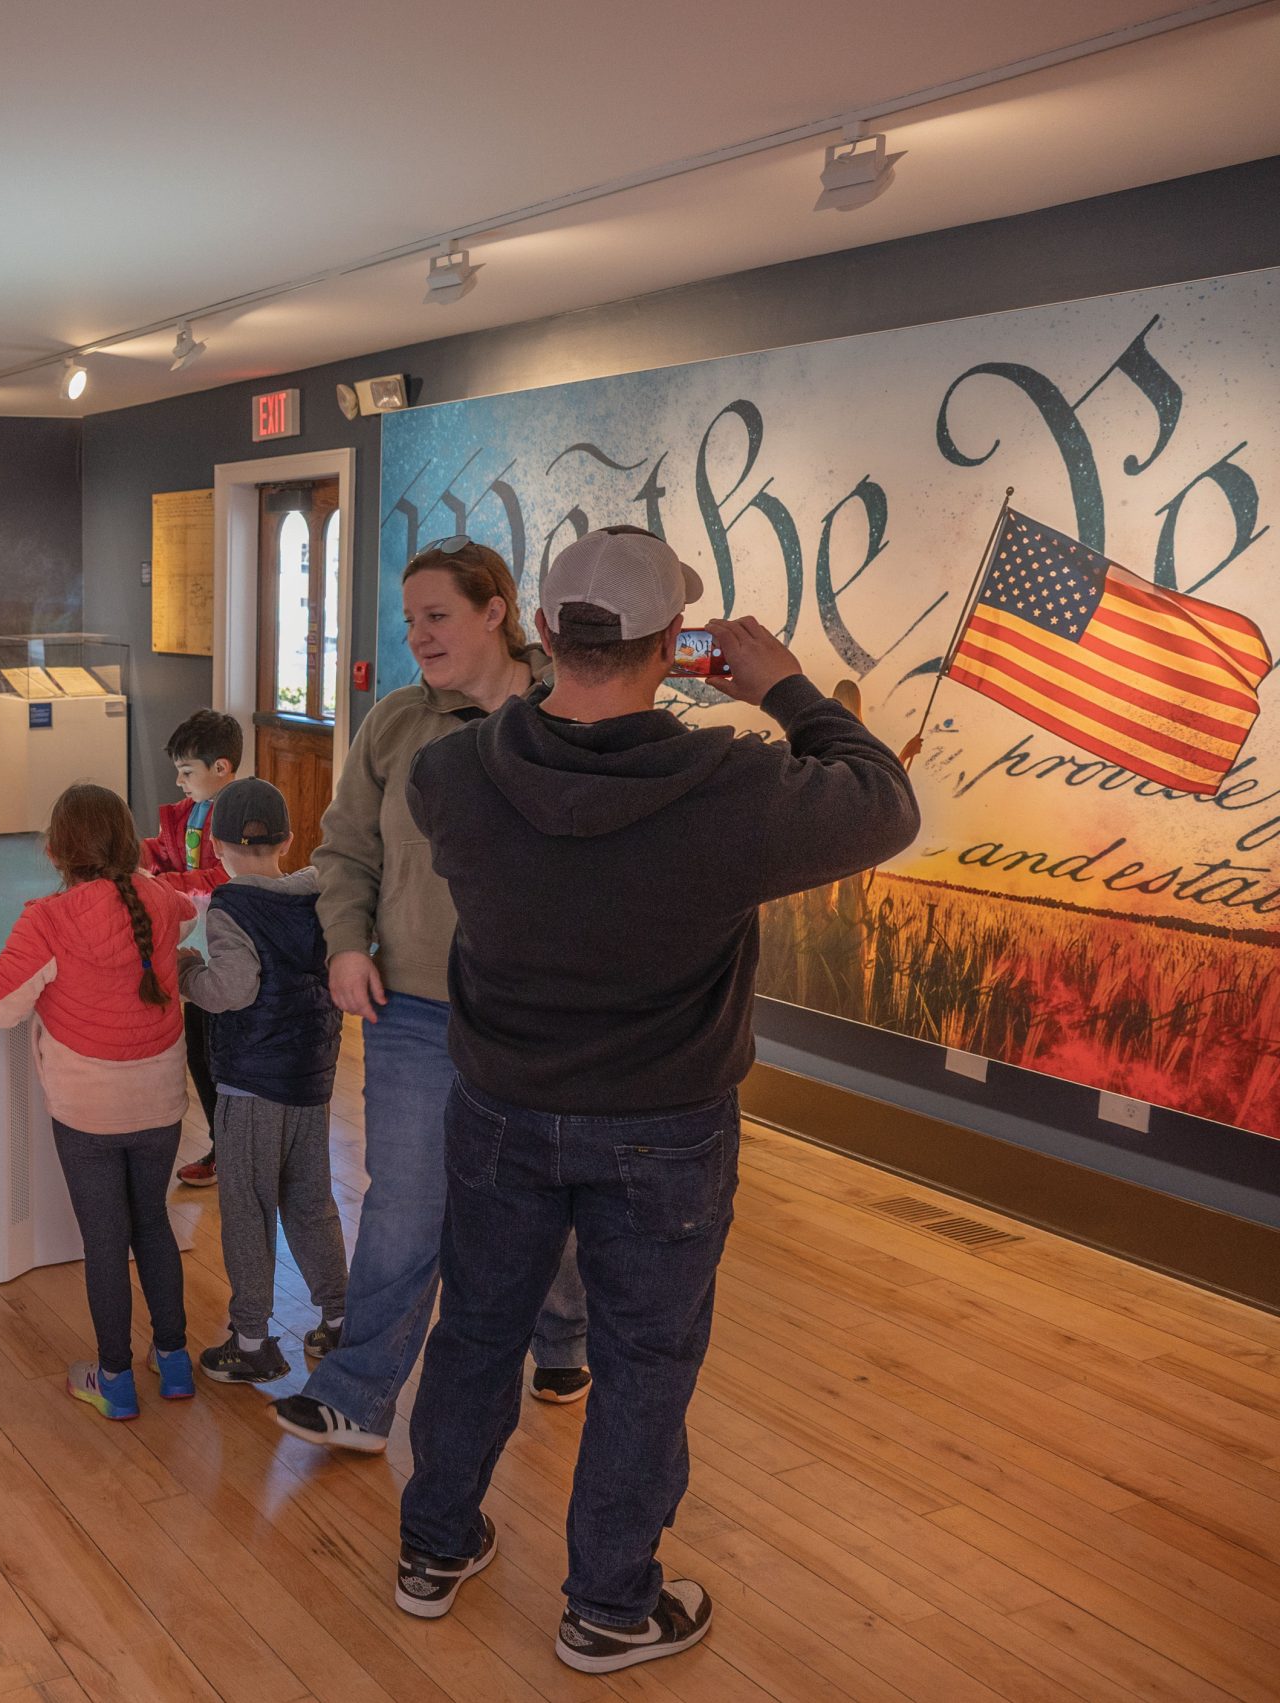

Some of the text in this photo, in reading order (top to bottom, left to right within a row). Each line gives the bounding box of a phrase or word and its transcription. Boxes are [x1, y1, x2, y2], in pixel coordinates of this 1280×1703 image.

[258, 391, 287, 436] EXIT
[957, 837, 1280, 914] and esta
